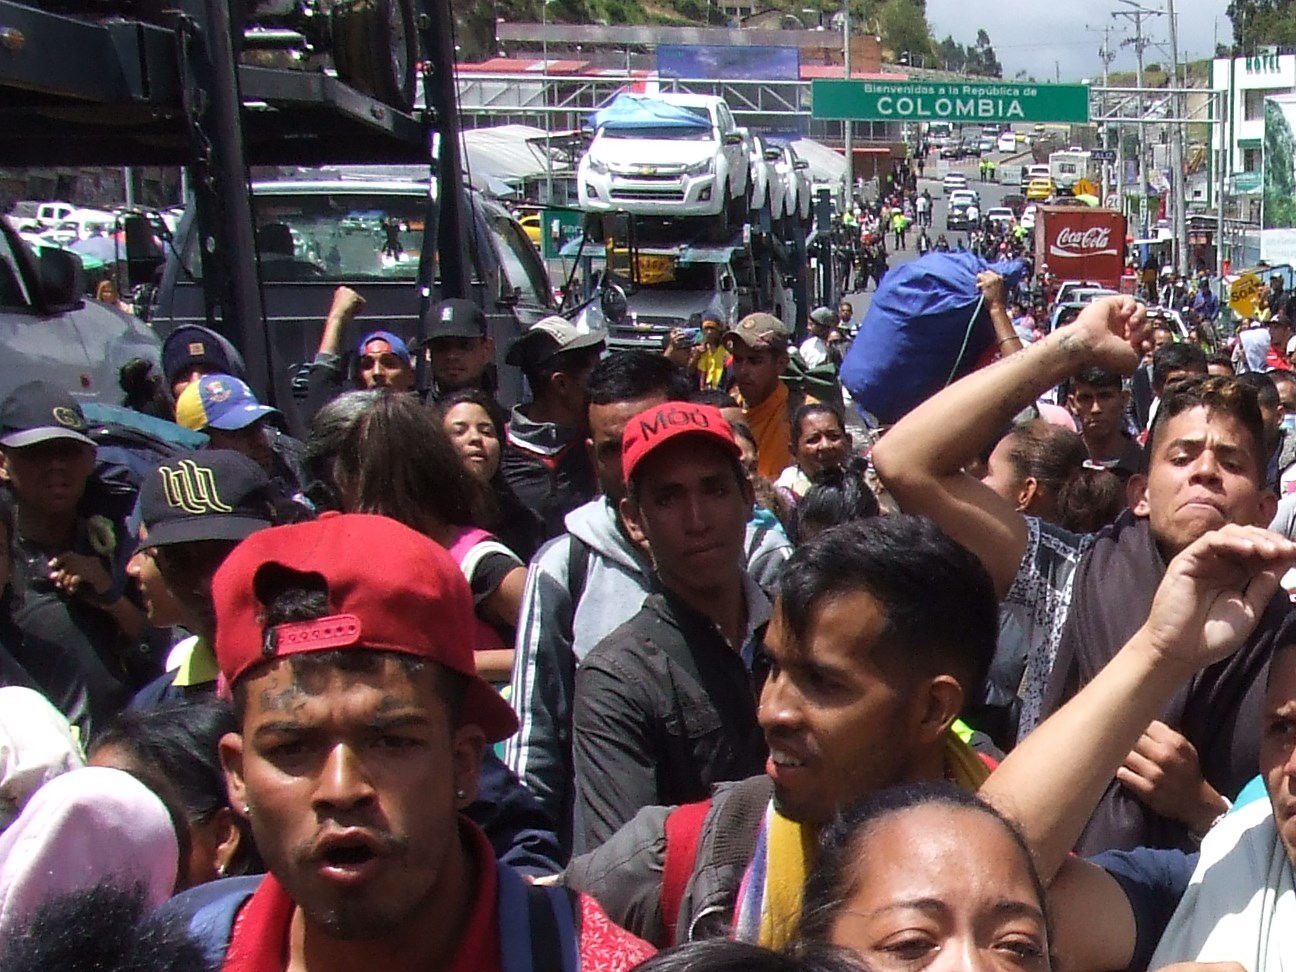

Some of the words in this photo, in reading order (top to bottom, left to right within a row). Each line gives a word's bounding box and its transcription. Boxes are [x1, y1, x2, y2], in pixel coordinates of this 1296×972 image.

[1246, 51, 1281, 70] HOTEL
[864, 83, 935, 95] Bienvenidos
[938, 87, 946, 95] a
[949, 84, 959, 95] la
[962, 85, 1020, 97] República
[1022, 87, 1038, 97] de
[877, 96, 1025, 118] COLOMBIA
[1056, 226, 1112, 249] Coca-Cola
